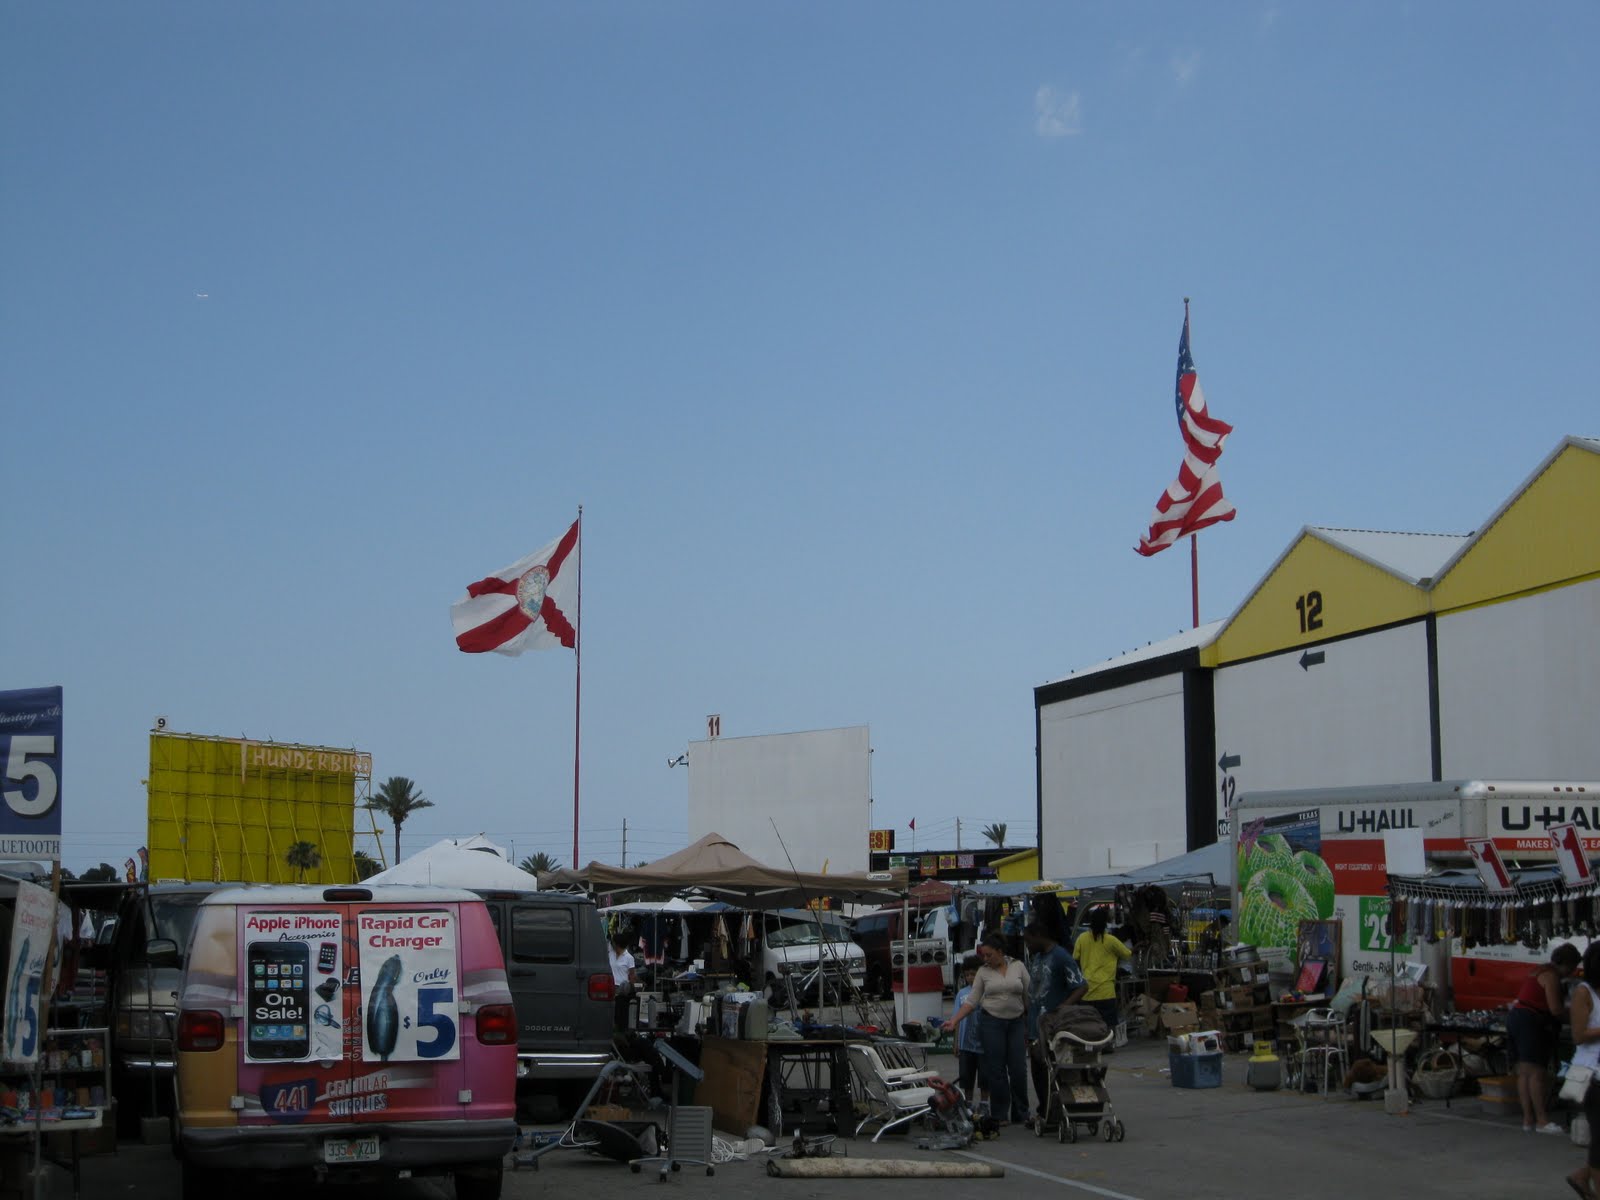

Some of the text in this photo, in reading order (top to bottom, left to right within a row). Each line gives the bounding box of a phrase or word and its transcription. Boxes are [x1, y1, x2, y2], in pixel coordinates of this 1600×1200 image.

[1296, 591, 1323, 633] 12
[157, 718, 166, 728] 9
[708, 716, 720, 737] 11
[228, 738, 372, 784] THUNDERBIRD
[1221, 775, 1236, 808] 12
[1298, 810, 1319, 821] TEXAS
[0, 840, 60, 855] UETOOTH
[1516, 839, 1549, 849] MAKES
[246, 916, 340, 932] Apple iPhone
[361, 916, 449, 932] Rapid Car
[279, 932, 336, 942] Accessories
[369, 935, 443, 950] Charger
[413, 968, 451, 985] Only
[265, 993, 295, 1006] On
[255, 1007, 303, 1020] Sale!
[326, 1075, 388, 1098] CELLULAR
[273, 1085, 308, 1114] 441
[328, 1094, 388, 1117] SUPPLIES
